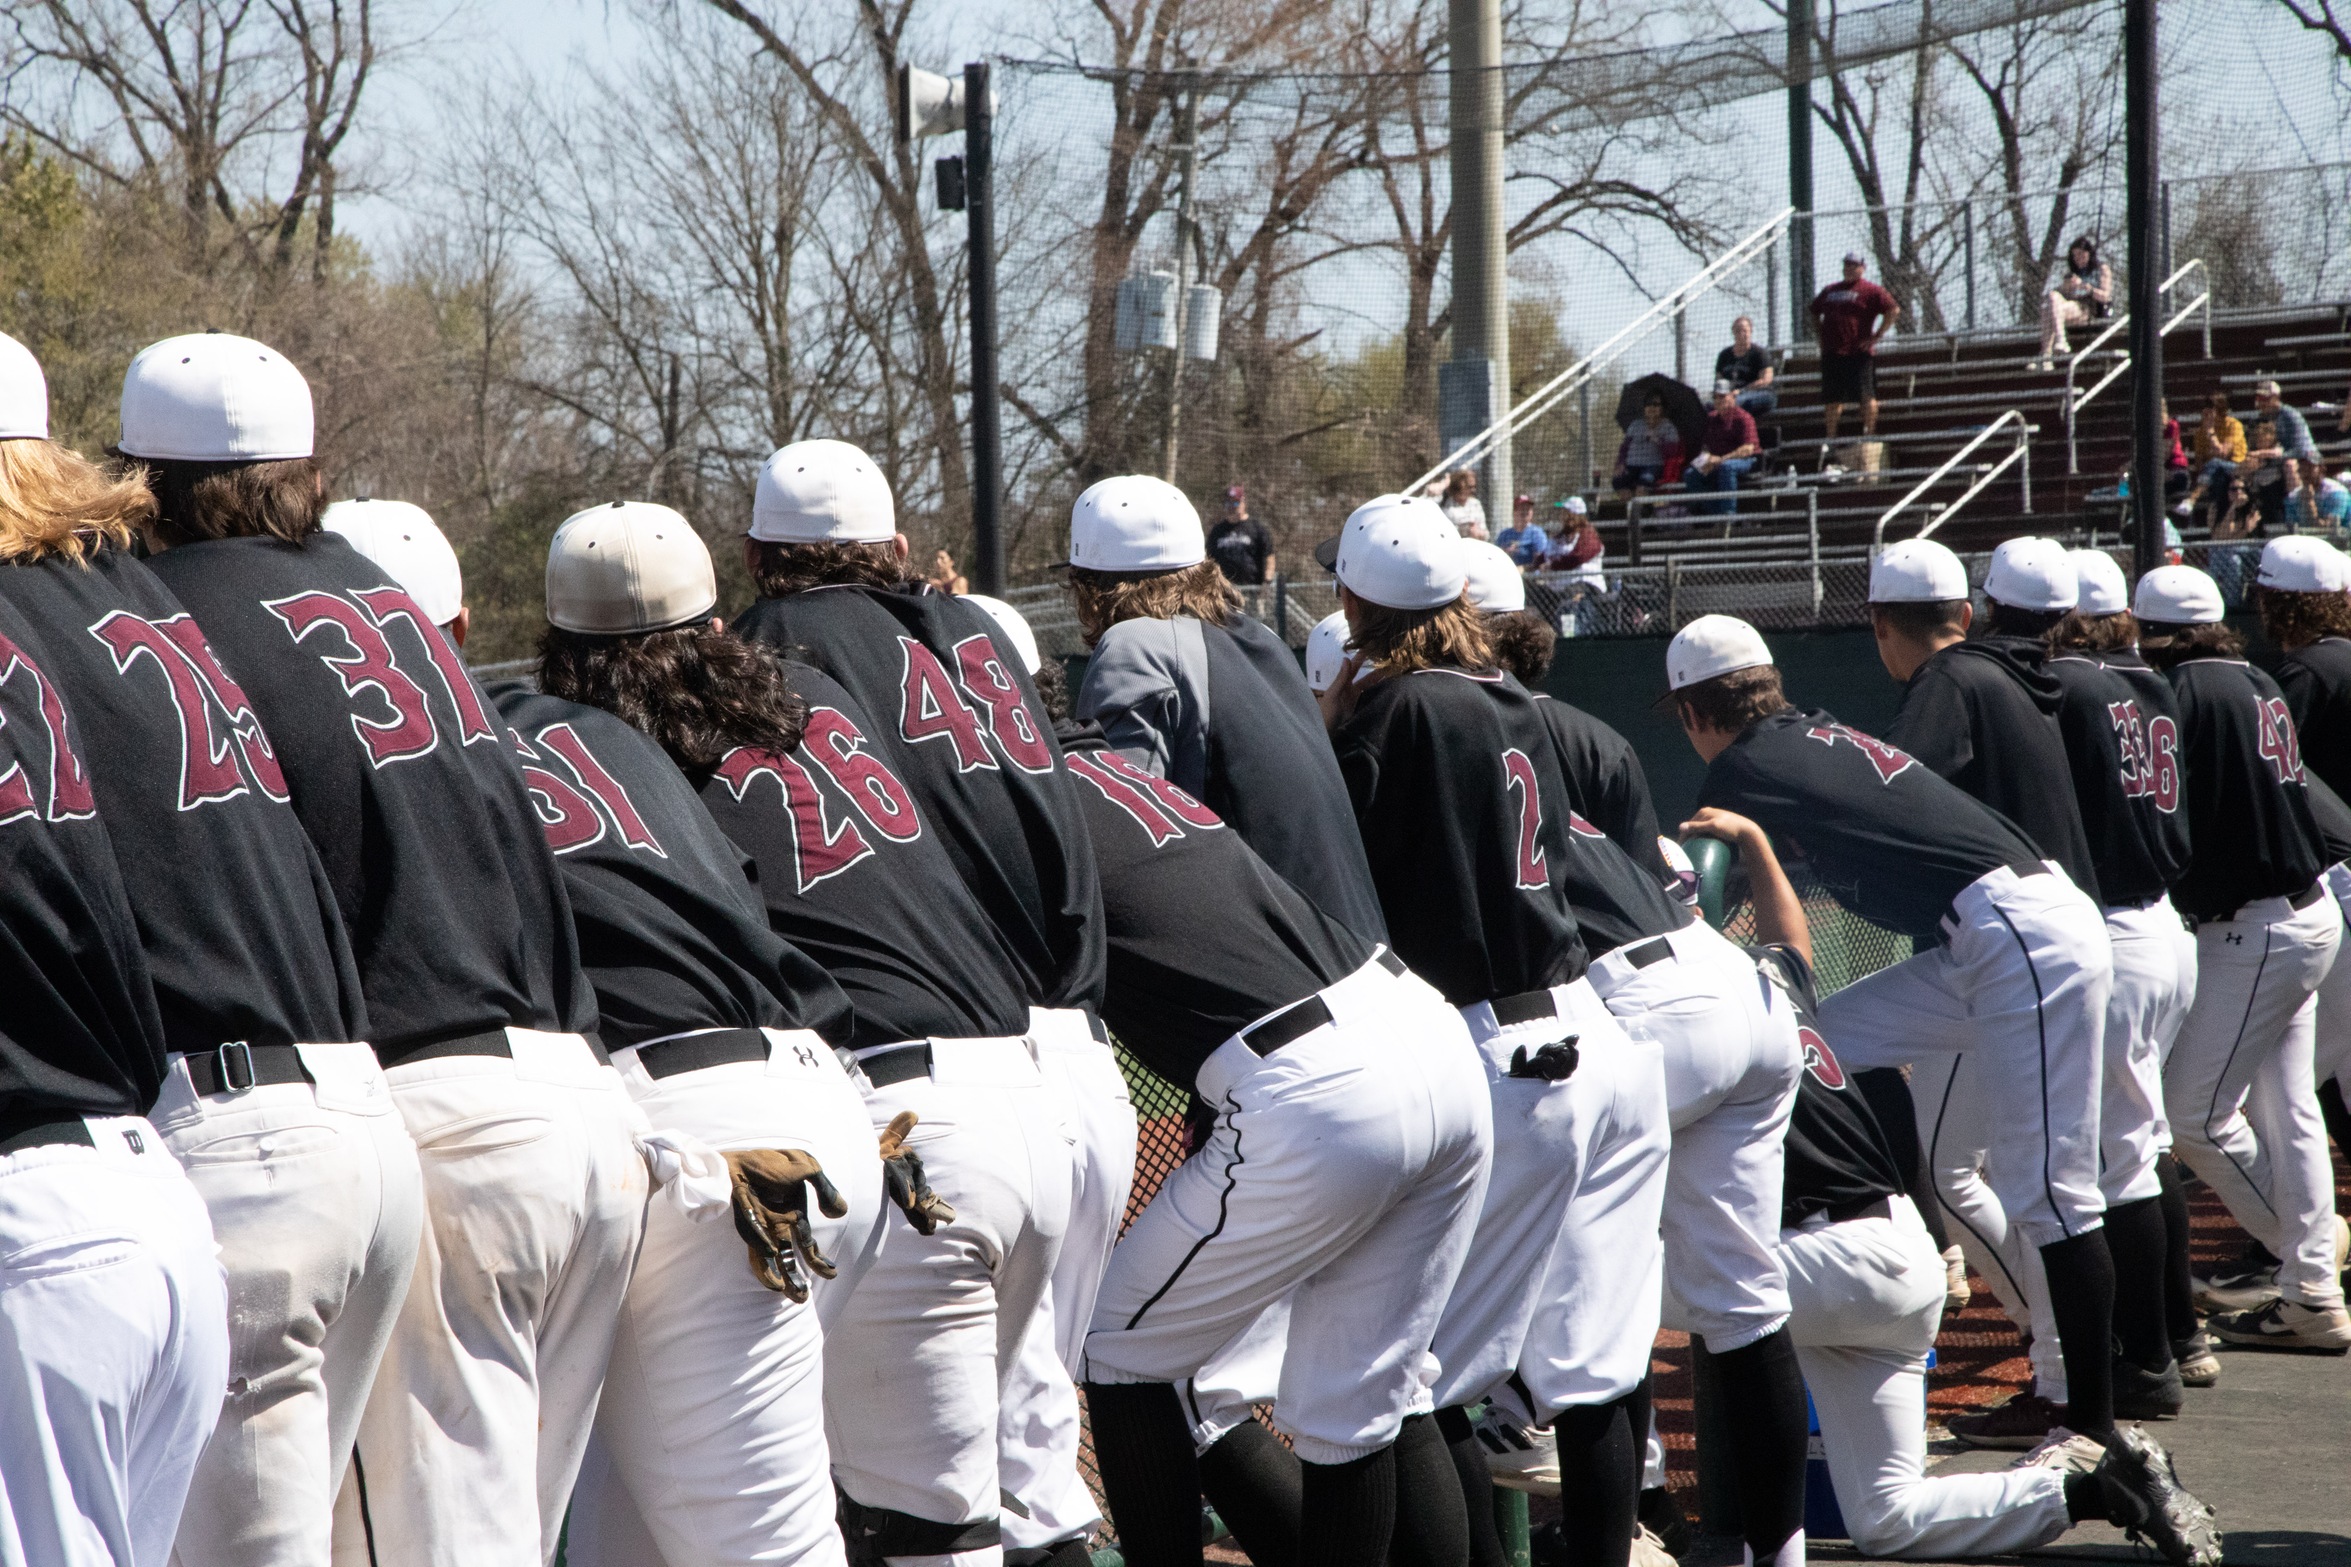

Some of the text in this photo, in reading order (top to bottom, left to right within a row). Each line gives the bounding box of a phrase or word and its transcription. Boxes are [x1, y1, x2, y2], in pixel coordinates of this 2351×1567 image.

[87, 609, 292, 811] 25
[260, 585, 499, 770] 37
[897, 634, 1054, 774] 48
[2253, 694, 2308, 787] 42
[712, 706, 922, 894] 26
[1502, 748, 1550, 890] 2
